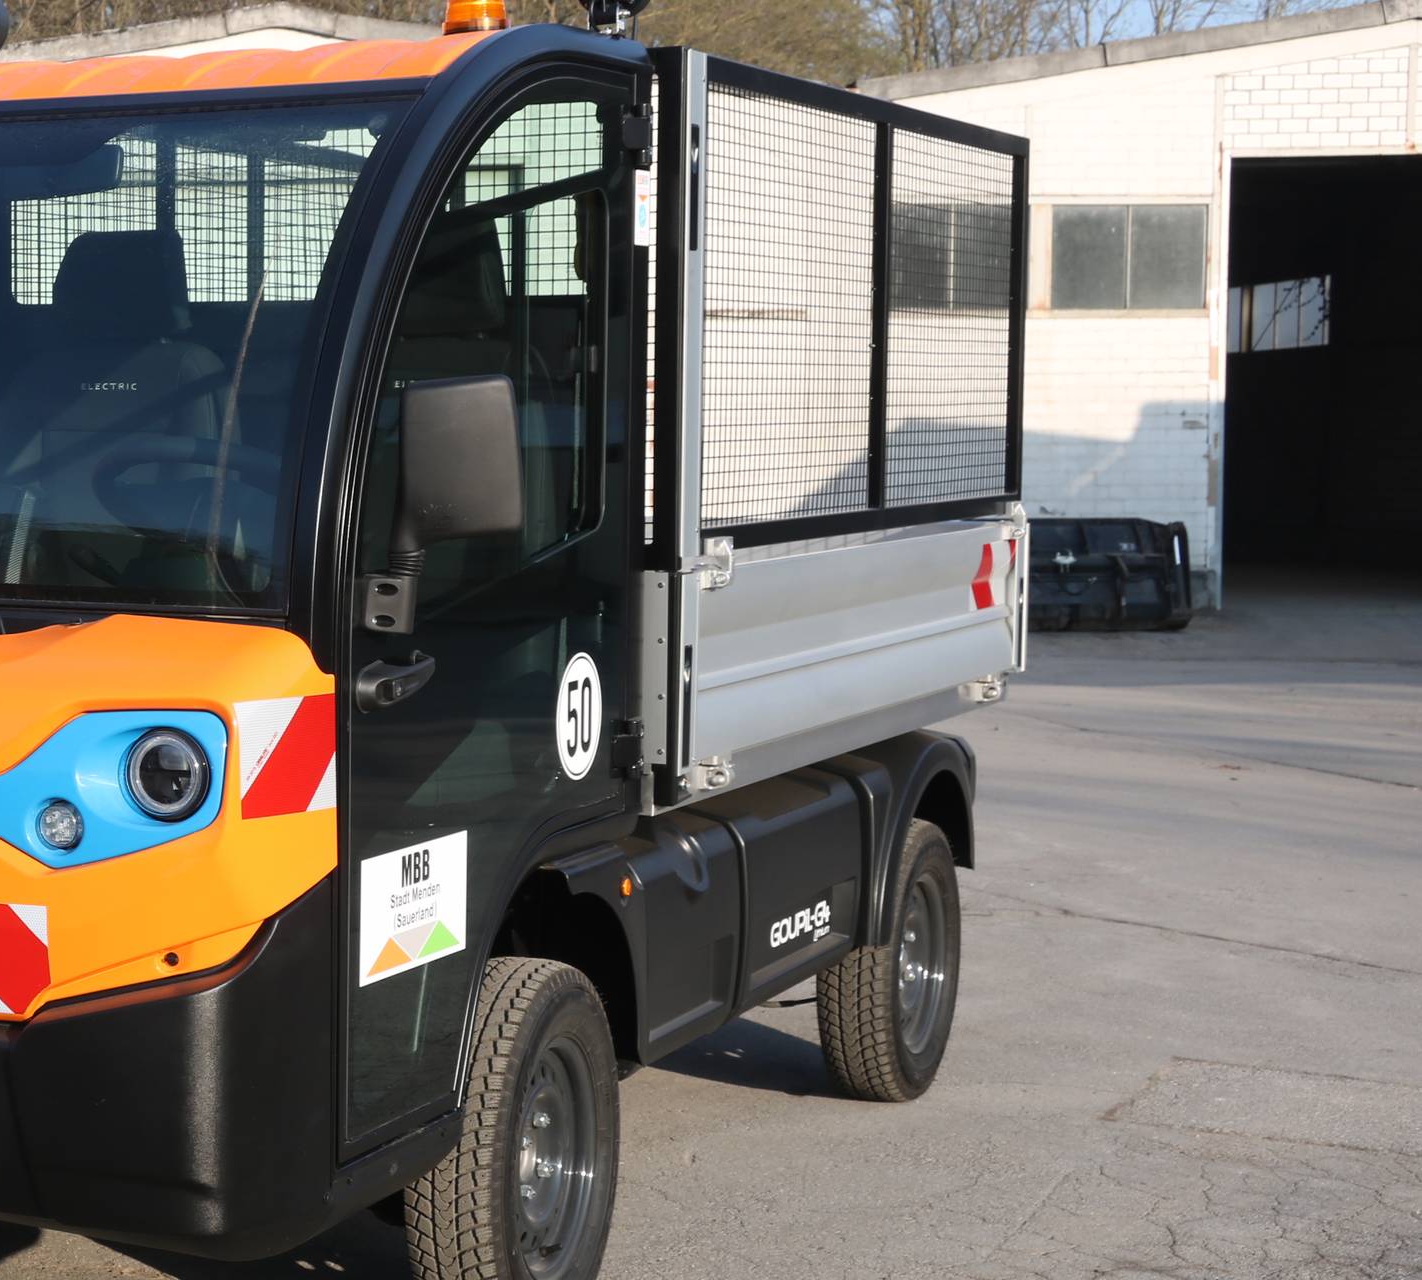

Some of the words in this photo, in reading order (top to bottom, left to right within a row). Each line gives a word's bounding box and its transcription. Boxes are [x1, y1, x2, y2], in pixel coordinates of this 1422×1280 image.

[81, 382, 138, 391] ELECTRIC
[567, 676, 592, 758] 50
[401, 848, 430, 888] MBB
[390, 890, 410, 909] Stadt
[412, 883, 441, 901] Menden
[393, 901, 438, 930] (Sauerland)
